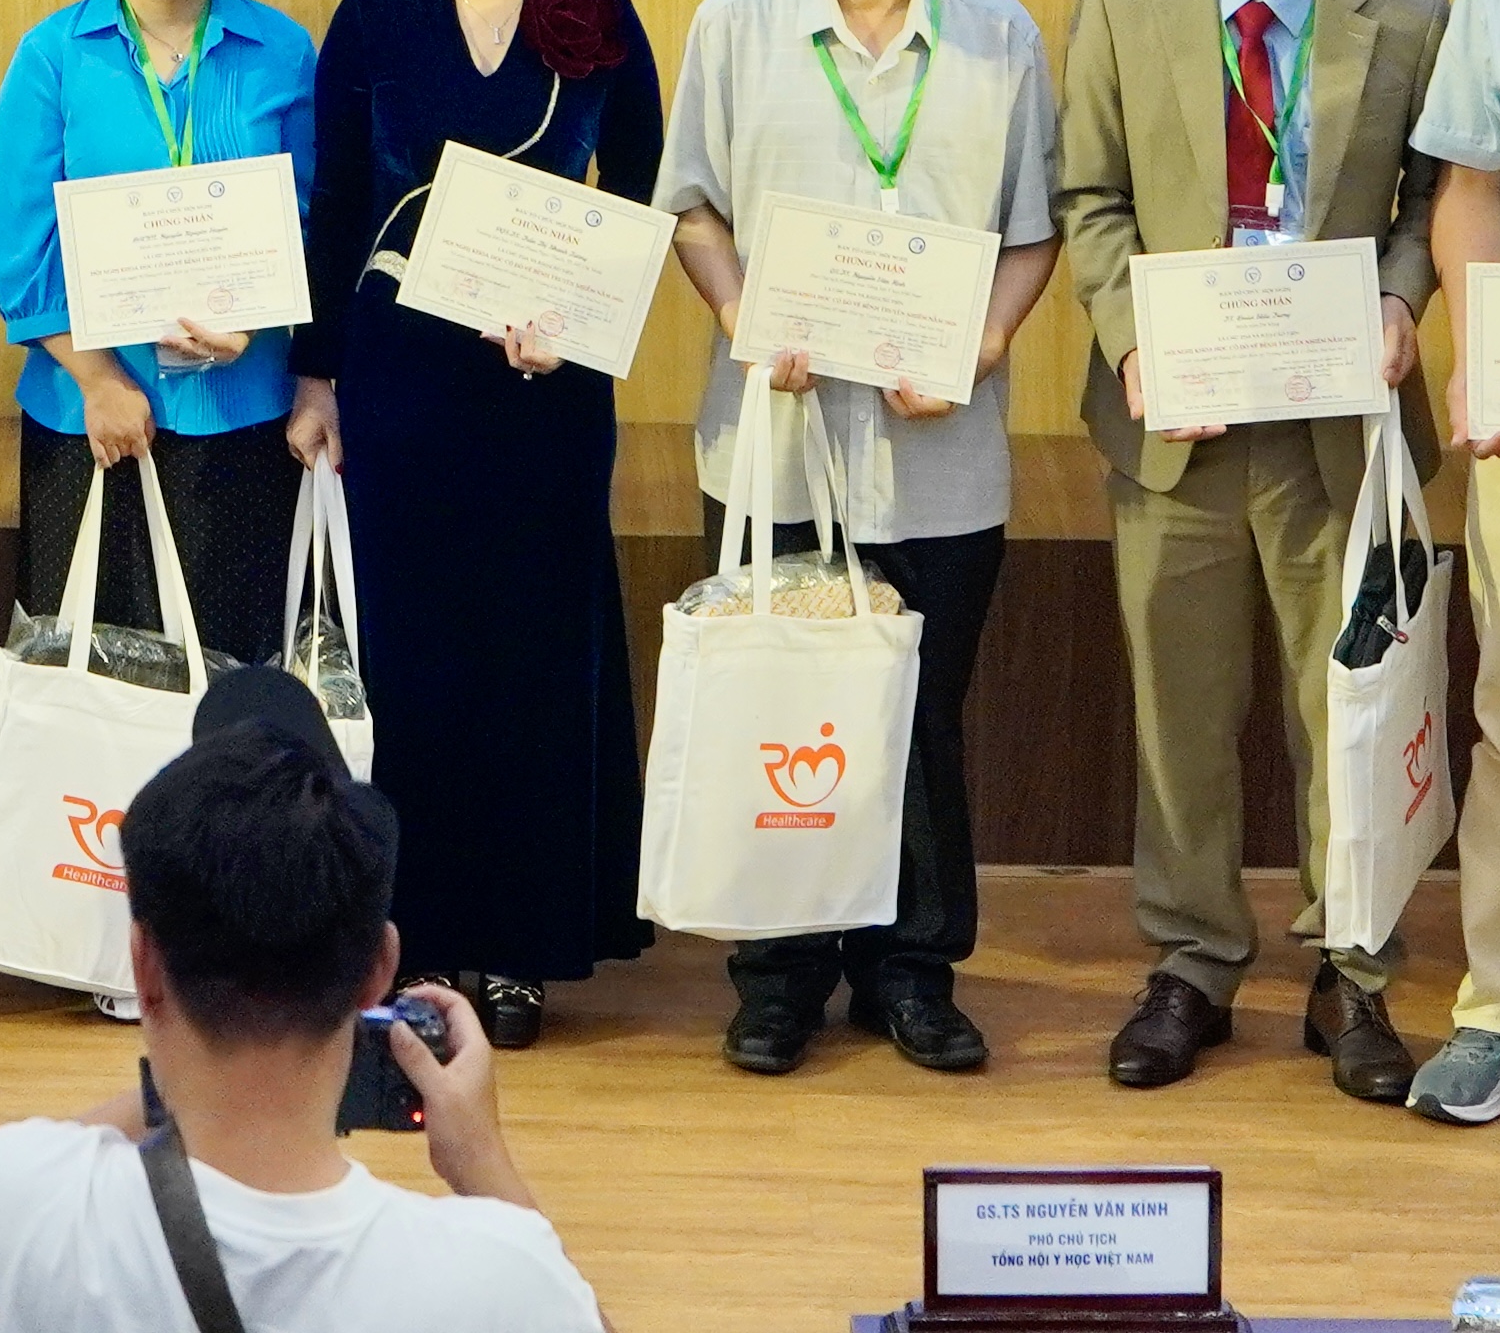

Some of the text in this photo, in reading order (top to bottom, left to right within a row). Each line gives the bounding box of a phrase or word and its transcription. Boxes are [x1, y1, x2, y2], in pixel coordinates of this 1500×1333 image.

[763, 815, 826, 827] Healthcare
[977, 1204, 1020, 1219] GS.TS
[1026, 1198, 1088, 1218] NGUYỄN
[1094, 1201, 1125, 1217] VĂN
[1029, 1230, 1117, 1247] PHÓ CHỦ TỊCH
[992, 1250, 1154, 1268] TỔNG HỘI Y HỌC VIỆT NAM
